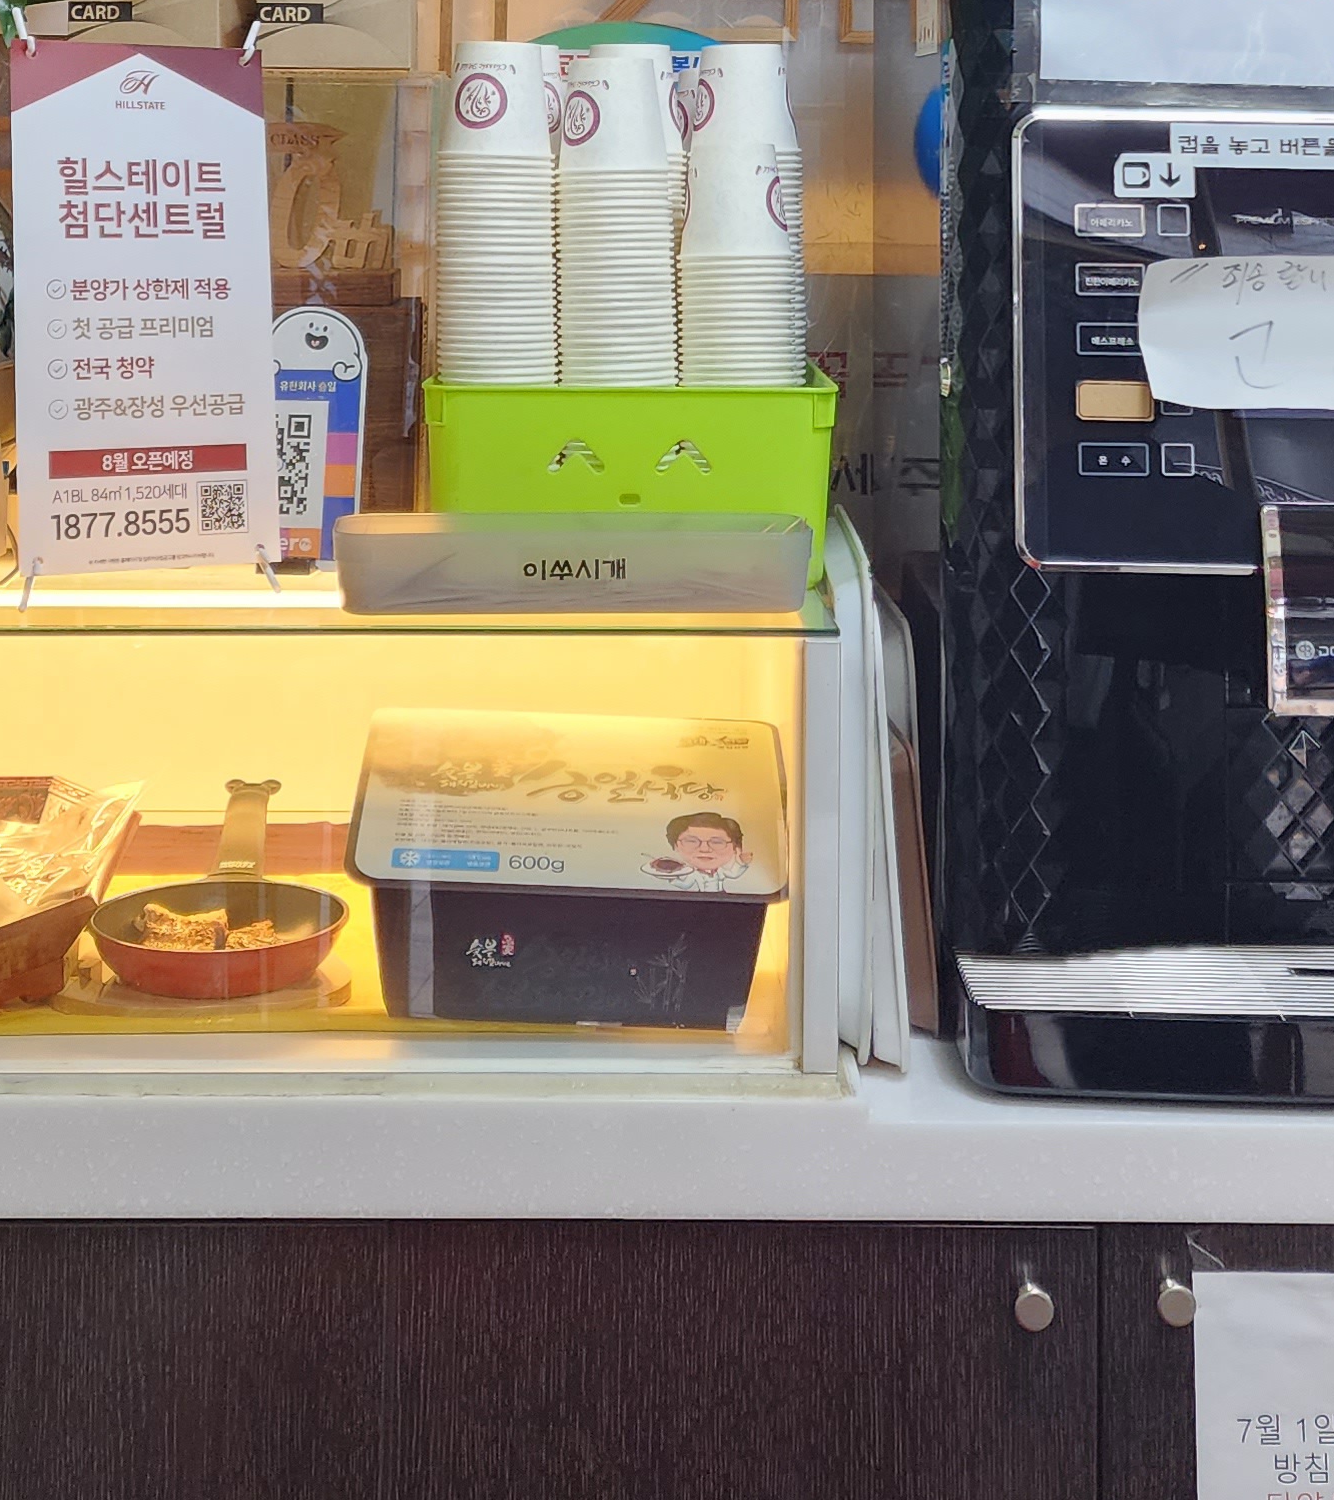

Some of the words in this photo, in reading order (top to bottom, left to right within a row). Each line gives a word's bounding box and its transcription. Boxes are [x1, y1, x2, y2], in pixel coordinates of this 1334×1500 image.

[71, 4, 120, 21] CARD
[260, 6, 311, 22] CARD
[115, 100, 166, 111] HILLSTATE
[270, 134, 320, 146] CLASS
[1178, 135, 1219, 155] 컵을
[1229, 137, 1269, 155] 놓고
[57, 157, 226, 196] 힐스테이트
[58, 200, 226, 240] 첨단센트럴
[1090, 217, 1134, 228] 아메리카노
[70, 278, 129, 301] 분양가
[133, 278, 190, 300] 상한제
[193, 278, 232, 300] 적용
[72, 318, 91, 340] 첫
[96, 317, 135, 340] 공급
[139, 316, 214, 339] 프리미엄
[72, 358, 111, 380] 전국
[115, 357, 155, 380] 청약
[73, 396, 165, 421] 광주&장성
[169, 394, 245, 417] 우선공급
[102, 452, 129, 473] 8월
[131, 450, 194, 471] 오픈예정
[53, 489, 89, 504] A1BL
[124, 483, 188, 502] 1,520세대
[50, 508, 191, 541] 1877.8555
[523, 558, 627, 582] 이쑤시개
[509, 855, 565, 873] 600g
[1237, 1413, 1282, 1443] 7월
